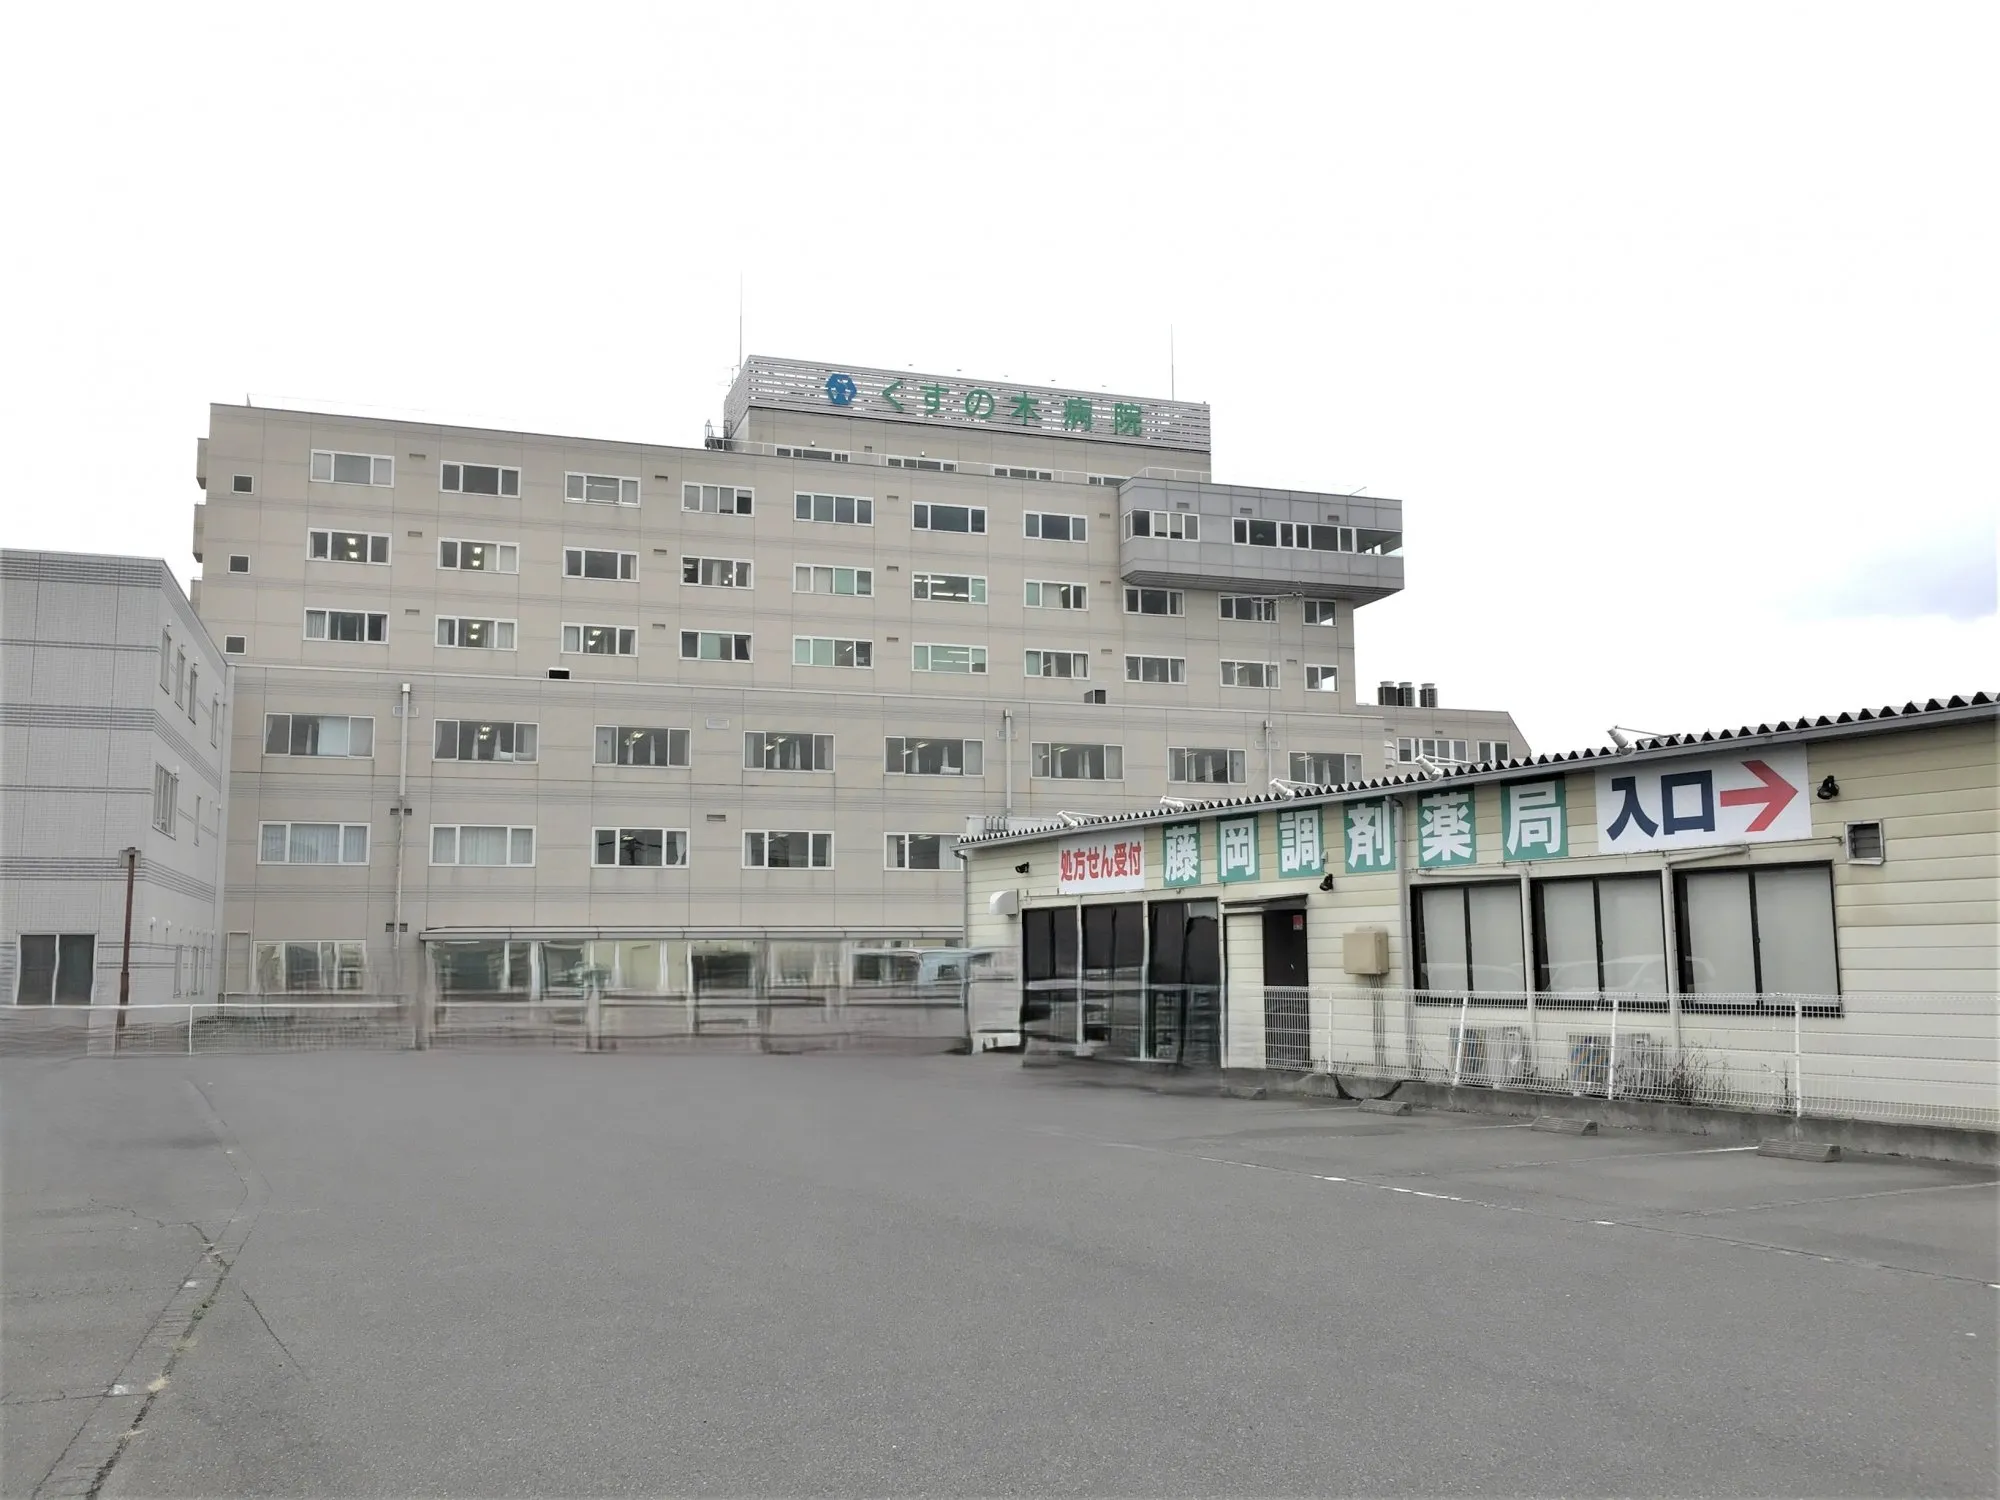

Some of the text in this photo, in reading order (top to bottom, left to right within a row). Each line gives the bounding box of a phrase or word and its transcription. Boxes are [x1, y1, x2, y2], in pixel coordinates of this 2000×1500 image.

[882, 382, 1143, 437] くすの木病院
[1165, 784, 1562, 881] 藤岡調剤薬局
[1606, 769, 1716, 840] 入口
[1060, 841, 1142, 882] 処方せん受付
